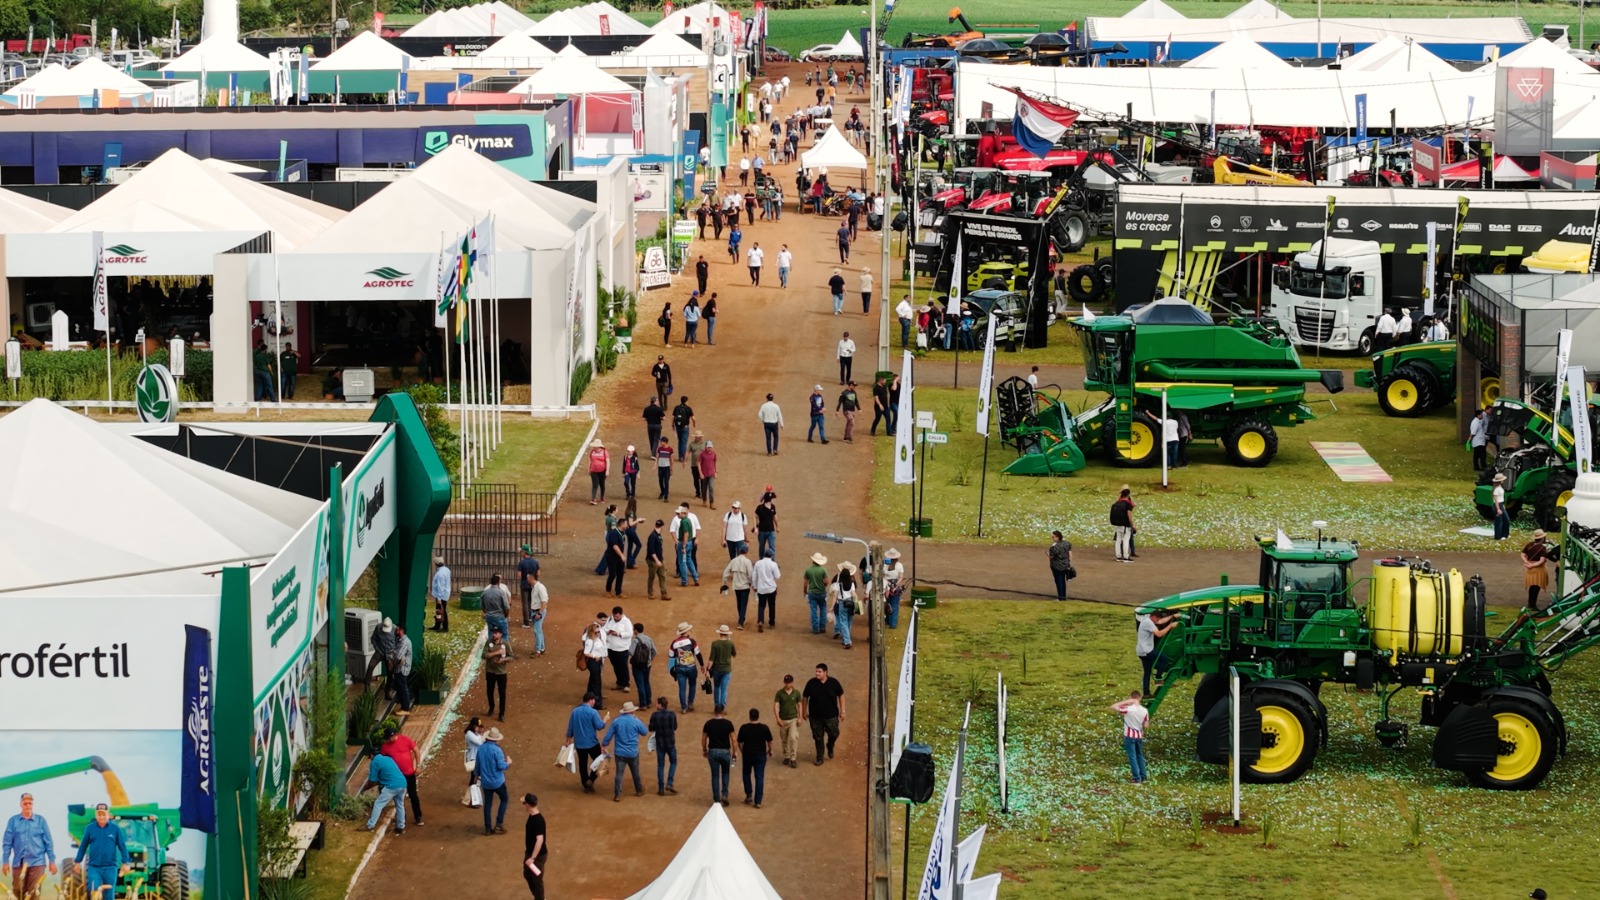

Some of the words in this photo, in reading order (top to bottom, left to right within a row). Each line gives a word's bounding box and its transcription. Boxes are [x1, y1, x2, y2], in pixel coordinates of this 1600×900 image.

[451, 134, 514, 150] Glymax
[1125, 211, 1170, 222] Moverse
[1139, 223, 1173, 232] crecer
[1558, 223, 1595, 236] Auto
[362, 280, 414, 288] AGROTEC
[1575, 389, 1584, 426] DEERE
